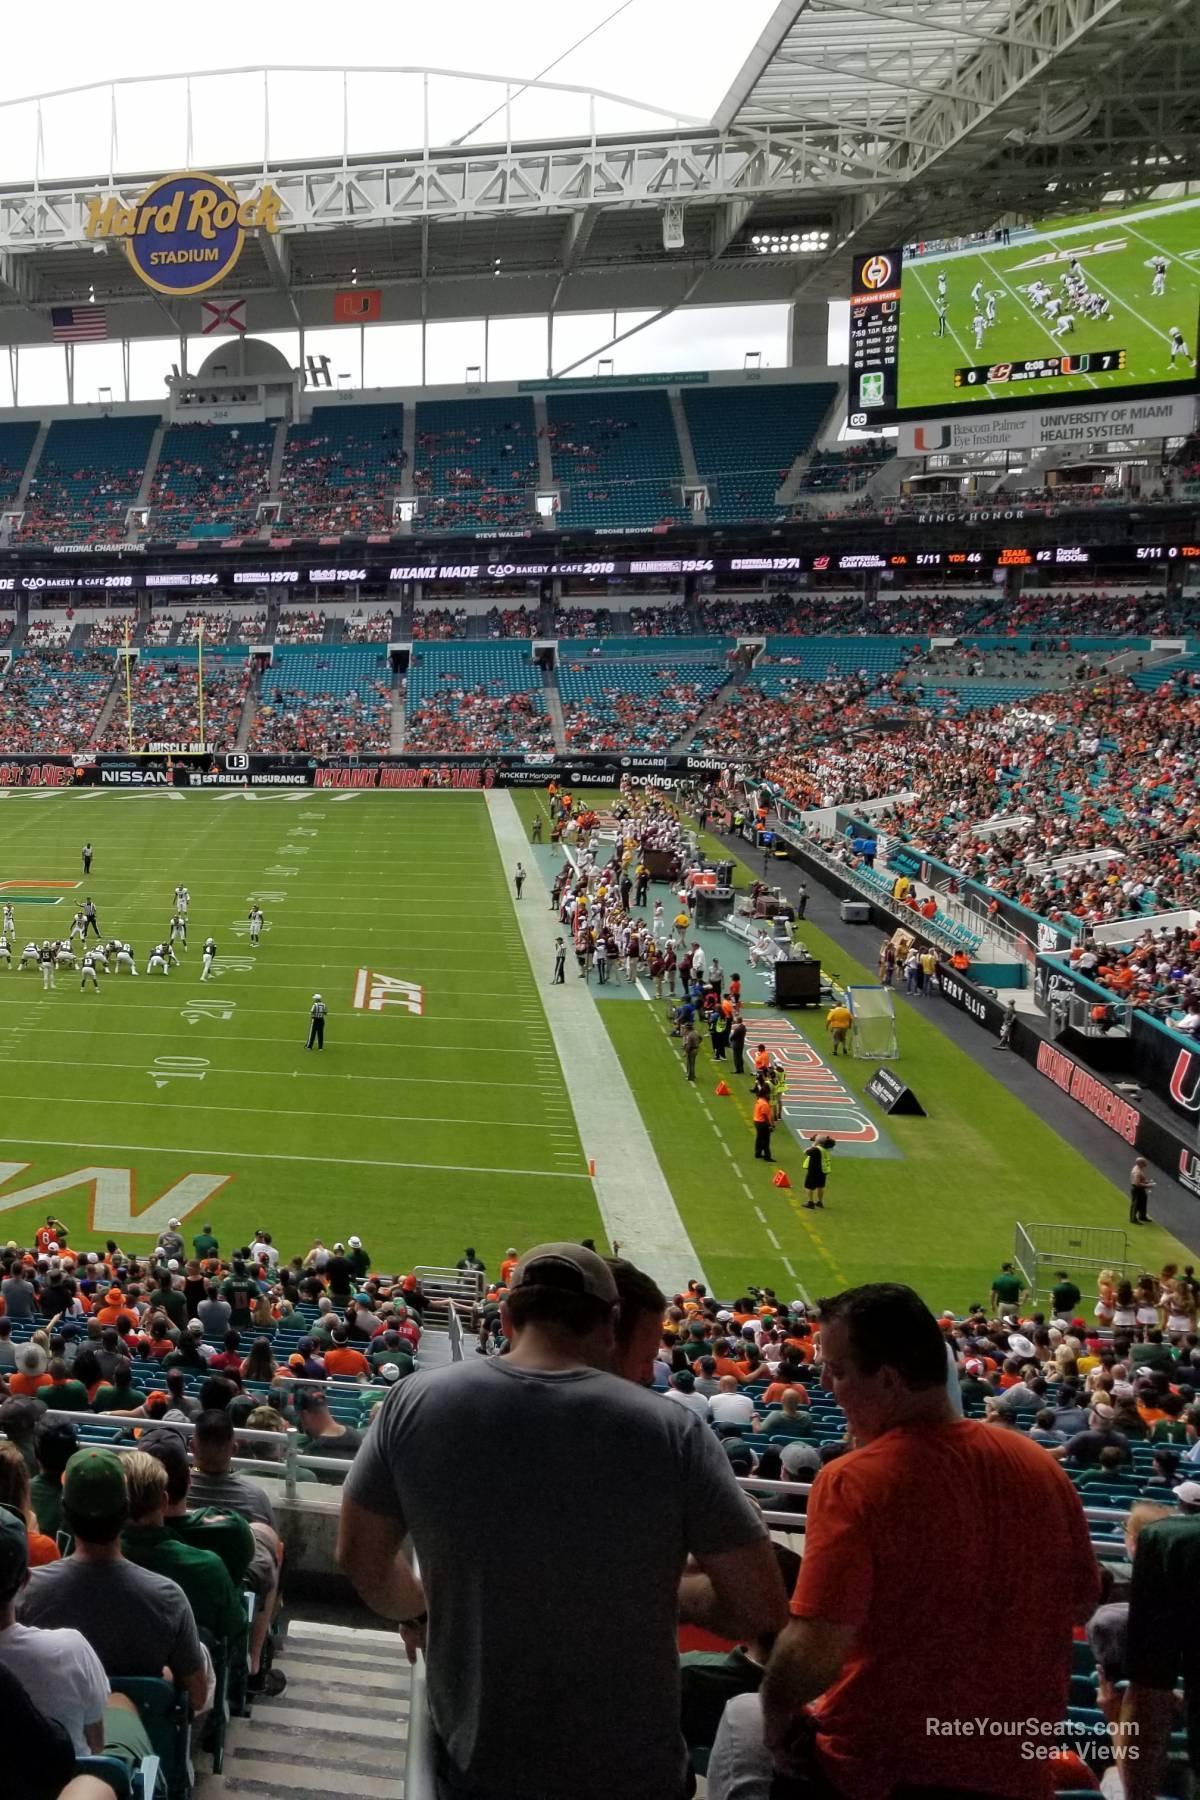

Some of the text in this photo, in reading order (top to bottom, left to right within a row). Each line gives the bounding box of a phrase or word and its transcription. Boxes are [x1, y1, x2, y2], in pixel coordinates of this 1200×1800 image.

[85, 185, 282, 240] Hard Rock
[150, 247, 219, 267] STADIUM
[886, 335, 895, 343] 27
[1102, 356, 1112, 369] 7
[852, 414, 865, 425] CC
[1040, 404, 1173, 428] UNIVERSITY OF MIAMI
[954, 418, 1025, 435] Bascom Palmer
[954, 431, 1011, 447] Eye Institute
[1040, 423, 1134, 443] HEALTH SYSTEM
[919, 510, 1024, 524] RING HONOR
[54, 542, 146, 554] NATIONAL CHAMPIONS
[1001, 549, 1027, 557] TEAM
[1037, 551, 1051, 561] #2
[1056, 547, 1081, 555] David
[1137, 548, 1161, 558] 5/11
[1168, 547, 1177, 557] 0
[891, 553, 982, 565] C/A 5/11 YDS 46
[998, 554, 1089, 565] LEADER MOORE
[390, 565, 480, 579] MIAMI MADE
[516, 565, 548, 574] BAKERY
[560, 564, 584, 573] CAFE
[583, 562, 616, 574] 2018
[681, 560, 714, 572] 1954
[47, 579, 75, 587] BAKERY
[85, 578, 105, 586] CAFE
[105, 576, 133, 587] 2018
[191, 574, 219, 585] 1954
[271, 571, 299, 582] 1978
[336, 570, 367, 581] 1984
[148, 742, 215, 753] MUSCLE MILK
[233, 755, 246, 768] 13
[102, 771, 168, 783] NISSAN
[203, 774, 248, 784] ESTRELLA
[313, 768, 378, 788] MIAMI
[500, 772, 561, 782] ROCKET Mortgage
[965, 993, 987, 1021] ELLIS
[1070, 1065, 1142, 1146] HURRICANES
[42, 1231, 50, 1245] 8
